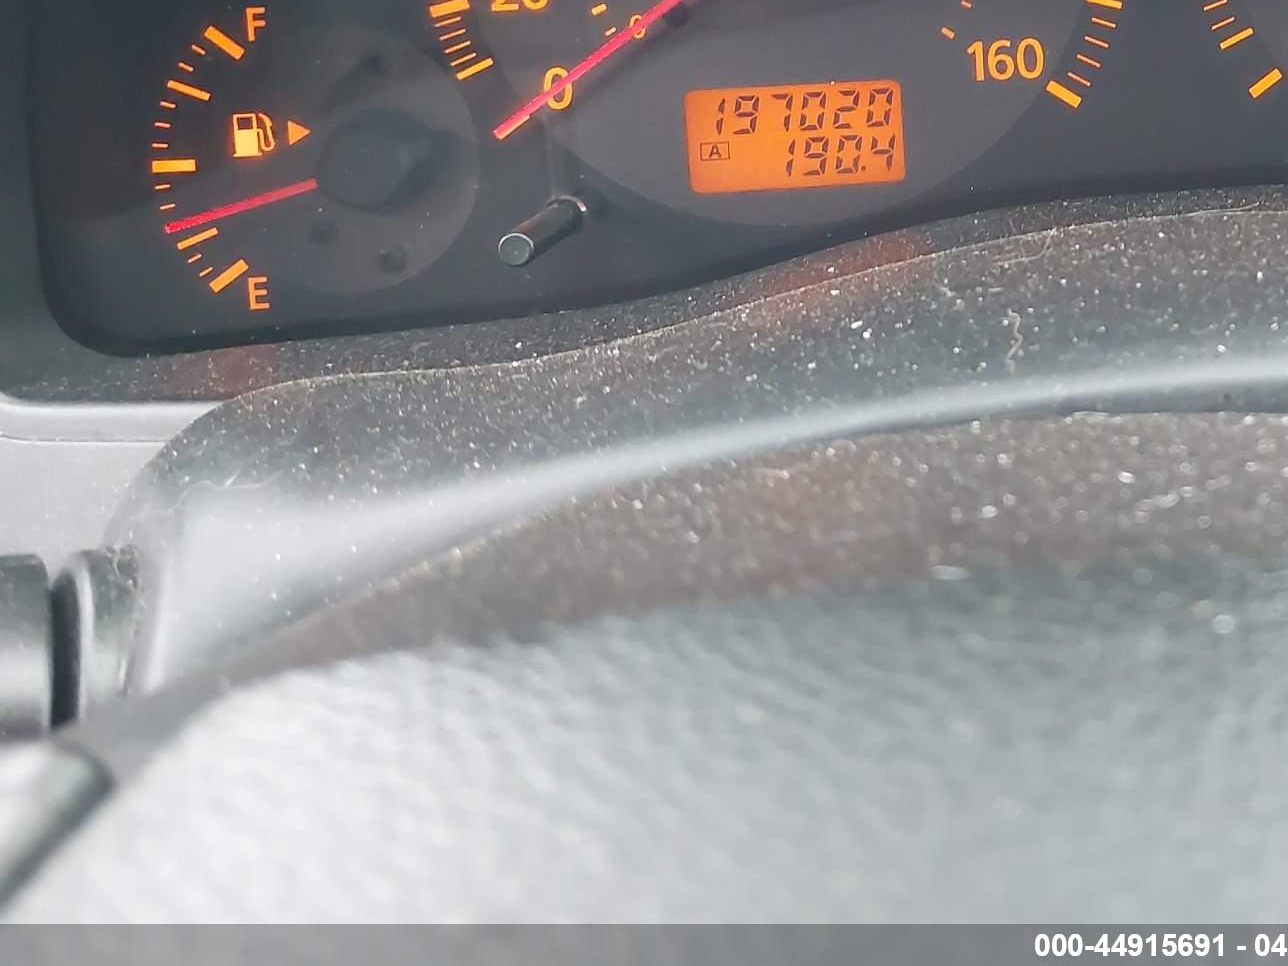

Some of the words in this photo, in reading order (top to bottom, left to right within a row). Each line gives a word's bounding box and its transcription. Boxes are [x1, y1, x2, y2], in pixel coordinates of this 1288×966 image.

[244, 6, 266, 41] F
[967, 38, 1044, 86] 160
[542, 67, 573, 110] 0
[715, 88, 894, 136] 197020
[708, 146, 722, 158] A
[784, 134, 896, 177] 190.4
[248, 276, 270, 310] E
